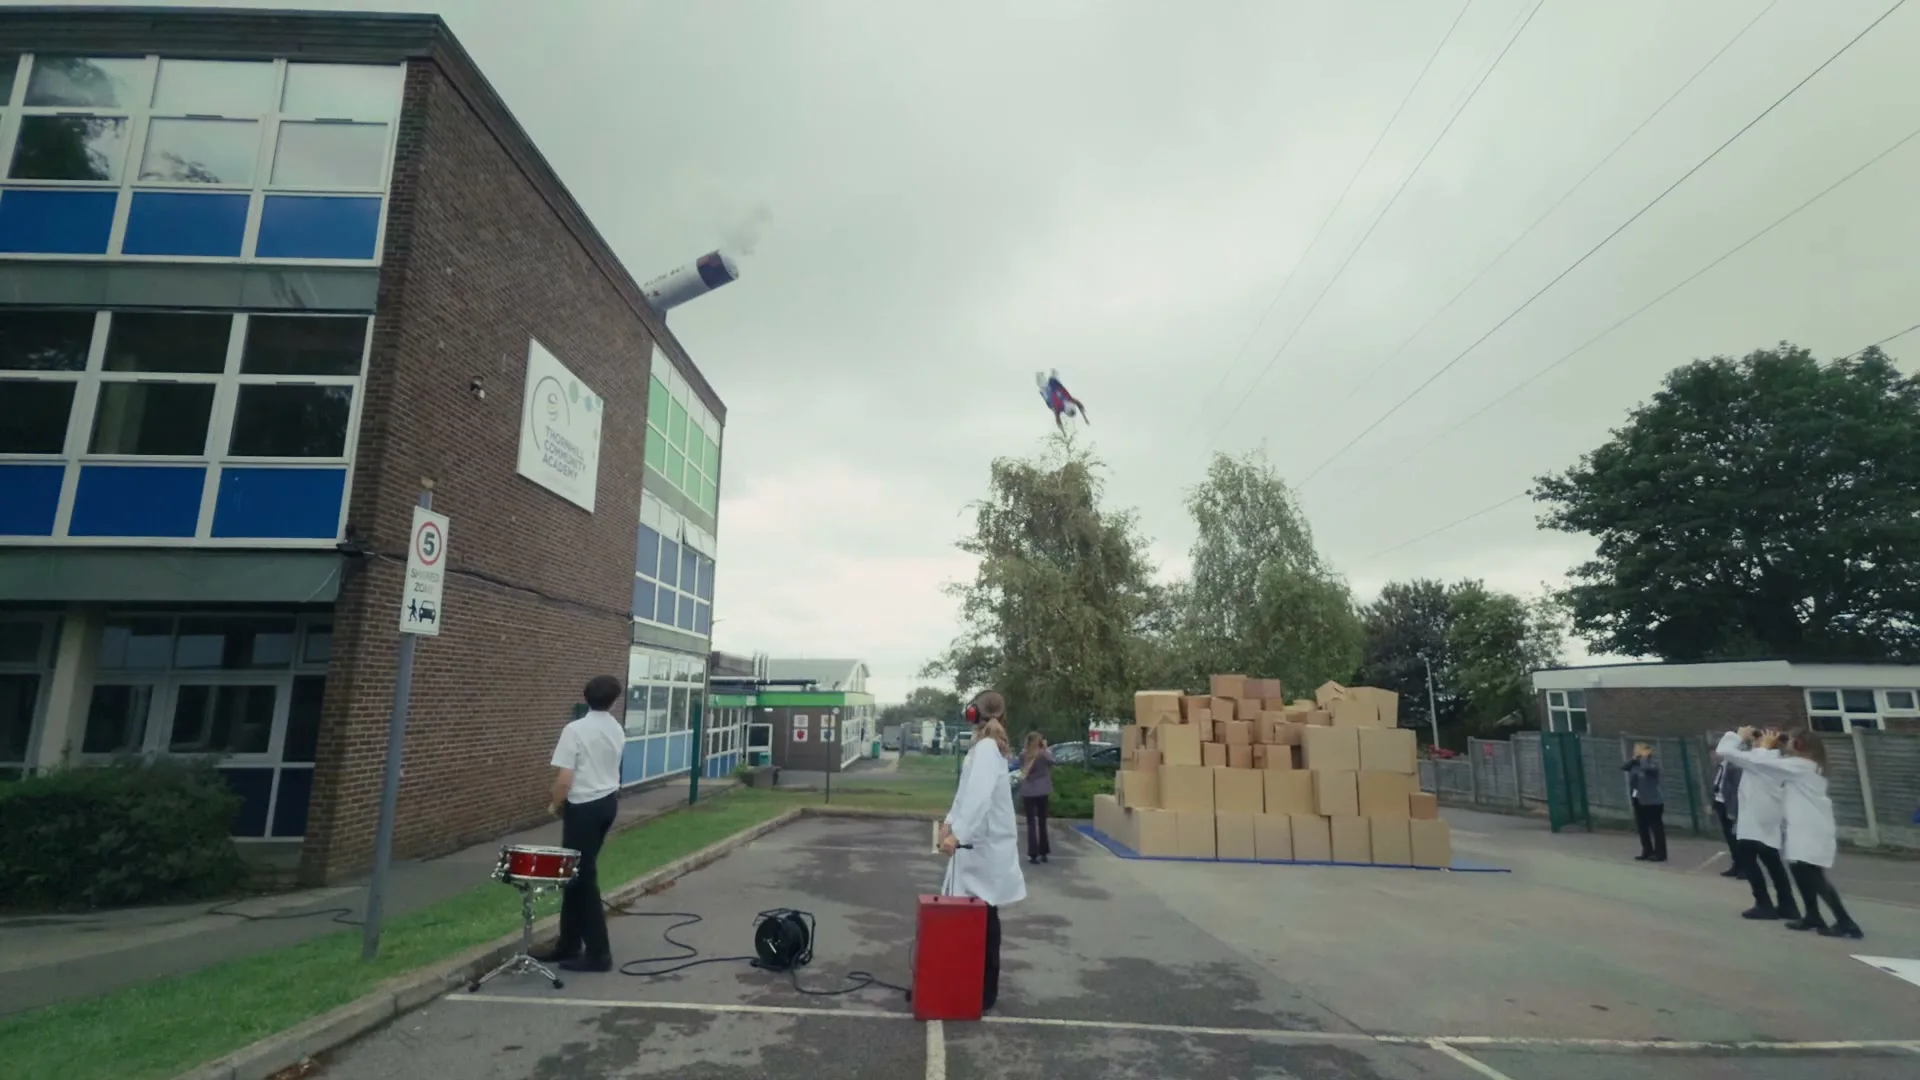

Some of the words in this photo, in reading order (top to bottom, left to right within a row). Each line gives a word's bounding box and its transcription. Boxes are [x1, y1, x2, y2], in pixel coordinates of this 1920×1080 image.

[542, 452, 578, 480] ACADEMY
[544, 440, 587, 473] COMMUNITY
[423, 531, 436, 556] 5
